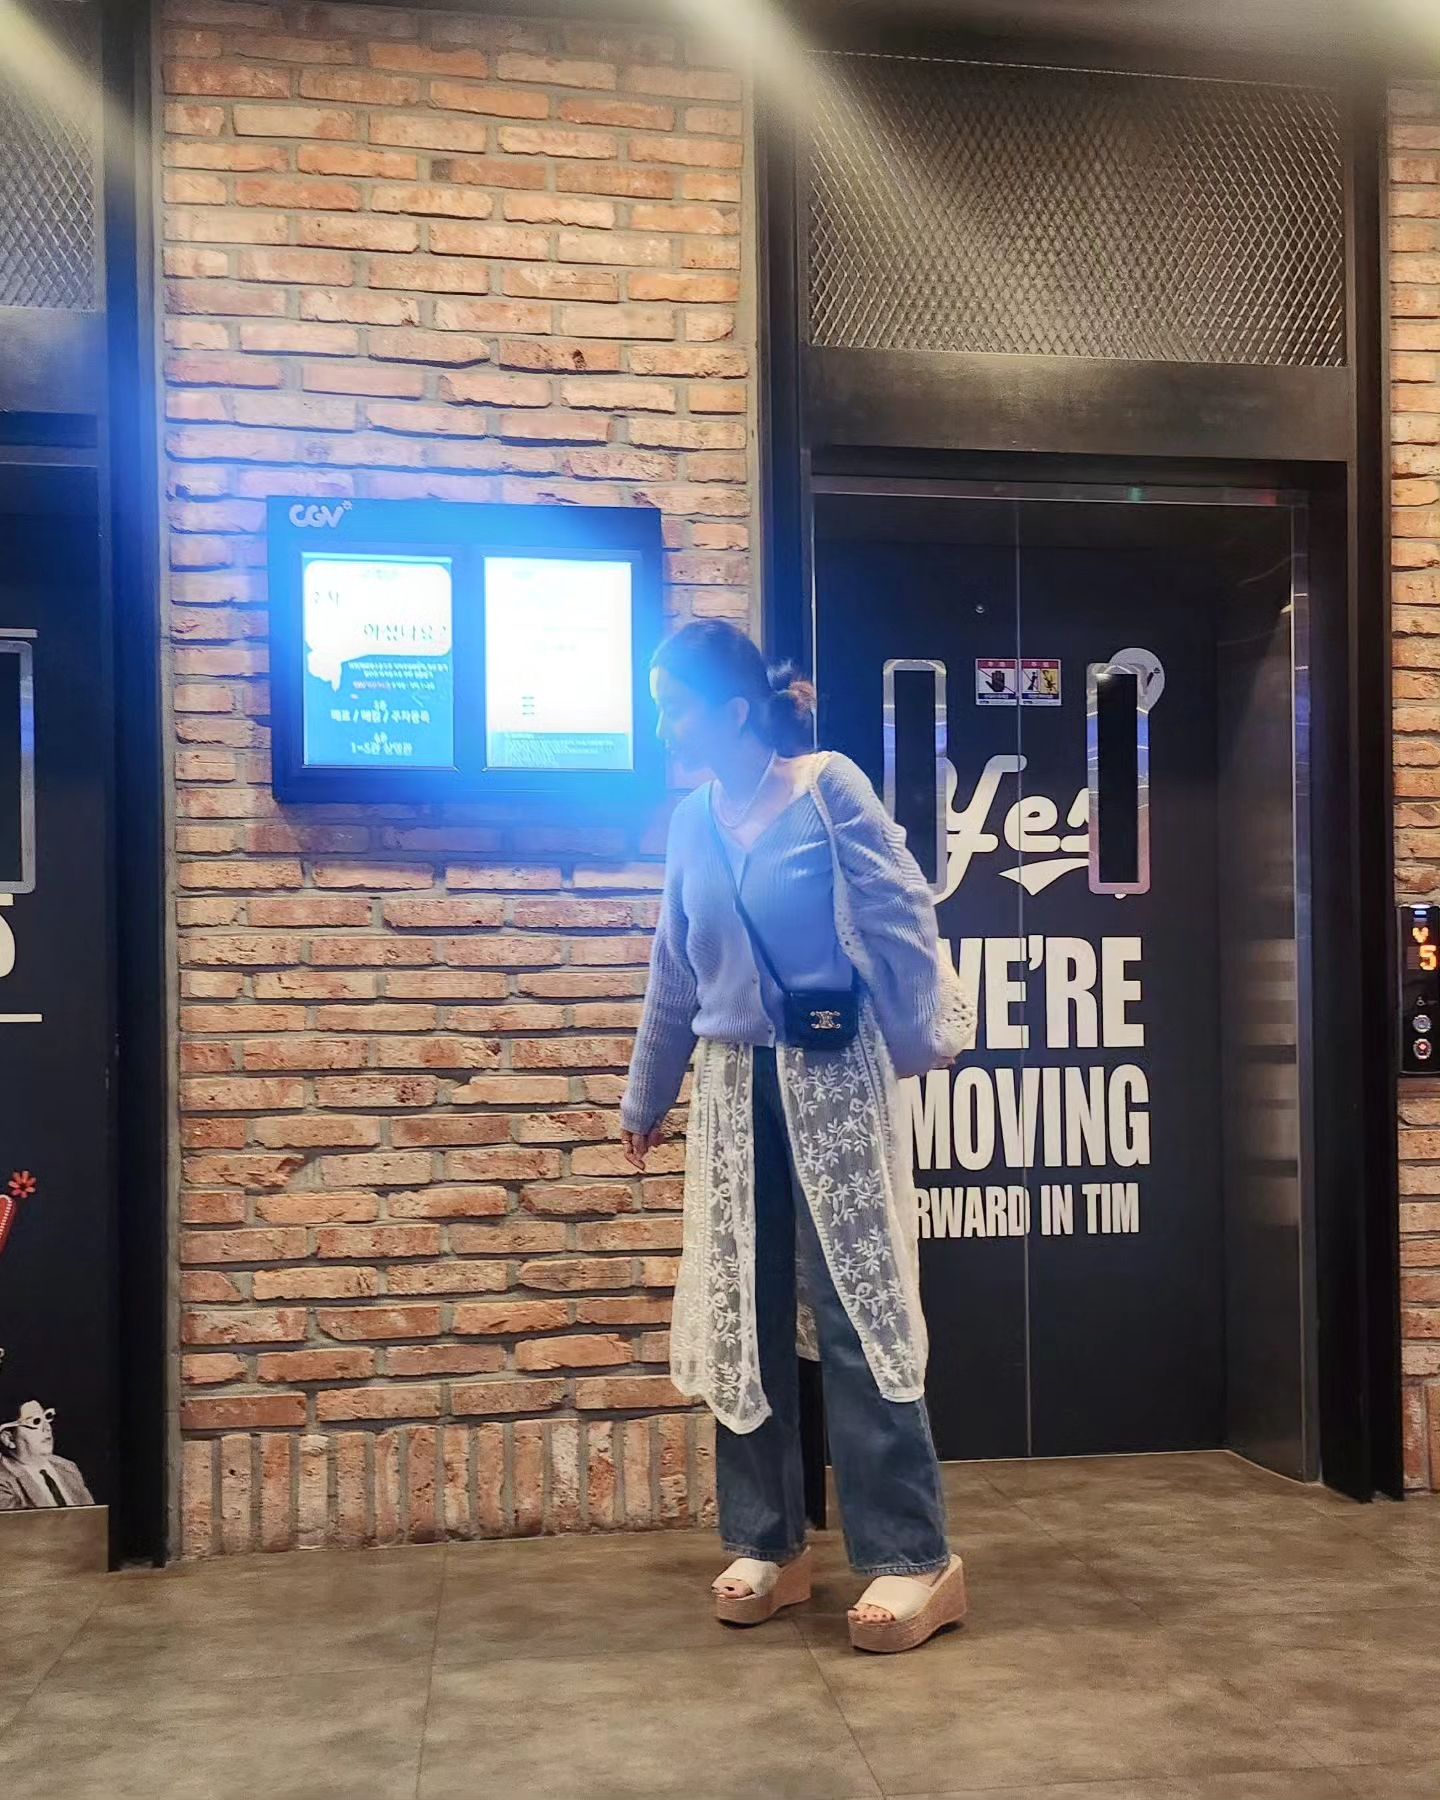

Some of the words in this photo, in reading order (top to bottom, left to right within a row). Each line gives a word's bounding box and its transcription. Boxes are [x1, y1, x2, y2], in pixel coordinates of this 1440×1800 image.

[289, 504, 345, 528] CGV
[1419, 945, 1437, 971] 5
[898, 1064, 1151, 1171] MOVING
[914, 1185, 1031, 1239] RWARD
[1040, 1184, 1073, 1236] IN
[1081, 1182, 1140, 1235] TIM
